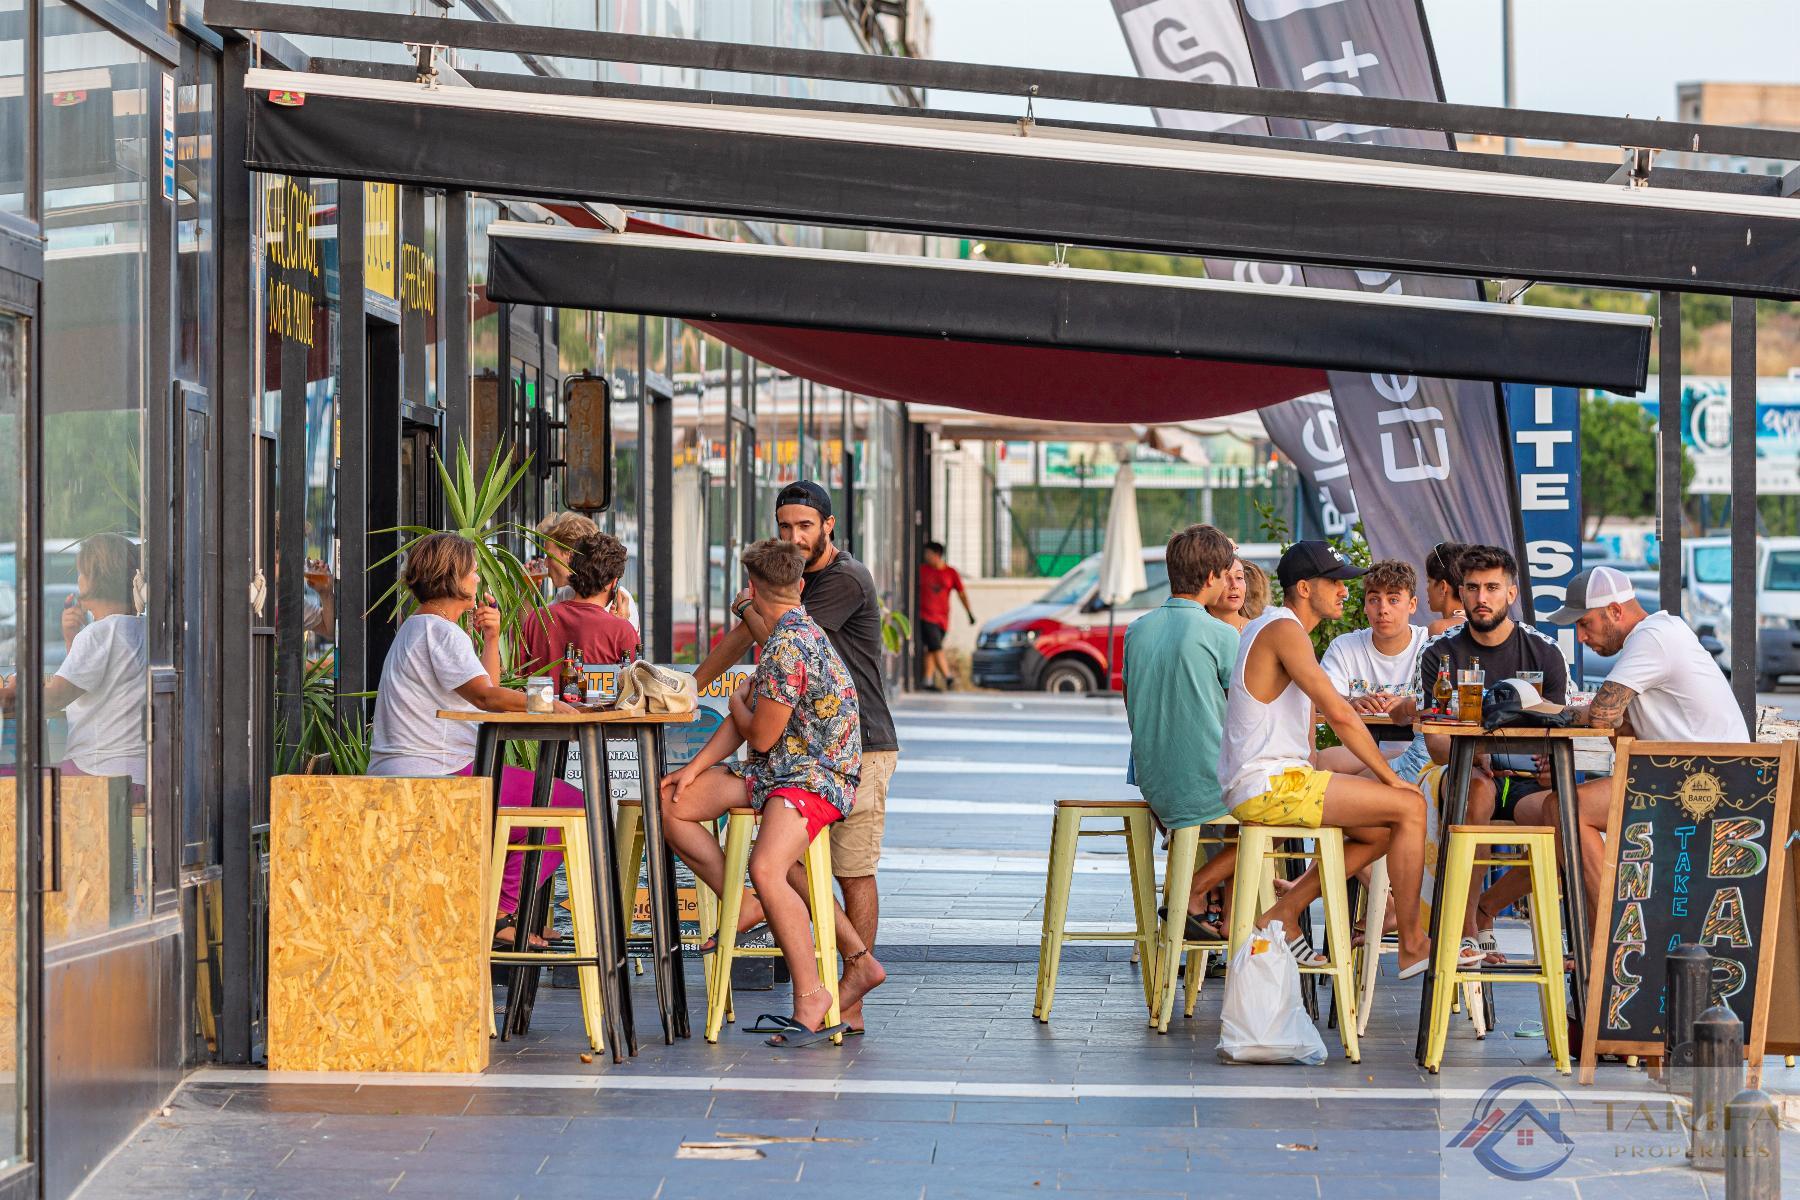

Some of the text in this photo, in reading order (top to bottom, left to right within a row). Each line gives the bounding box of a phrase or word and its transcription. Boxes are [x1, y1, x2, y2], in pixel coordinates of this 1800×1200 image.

[286, 176, 319, 278] SCHOOL
[1516, 388, 1573, 510] ITE
[582, 671, 615, 695] ITE
[611, 789, 627, 798] OP
[1688, 794, 1712, 802] BARCO
[1672, 825, 1697, 917] TAKE
[1607, 822, 1653, 1030] SNACK
